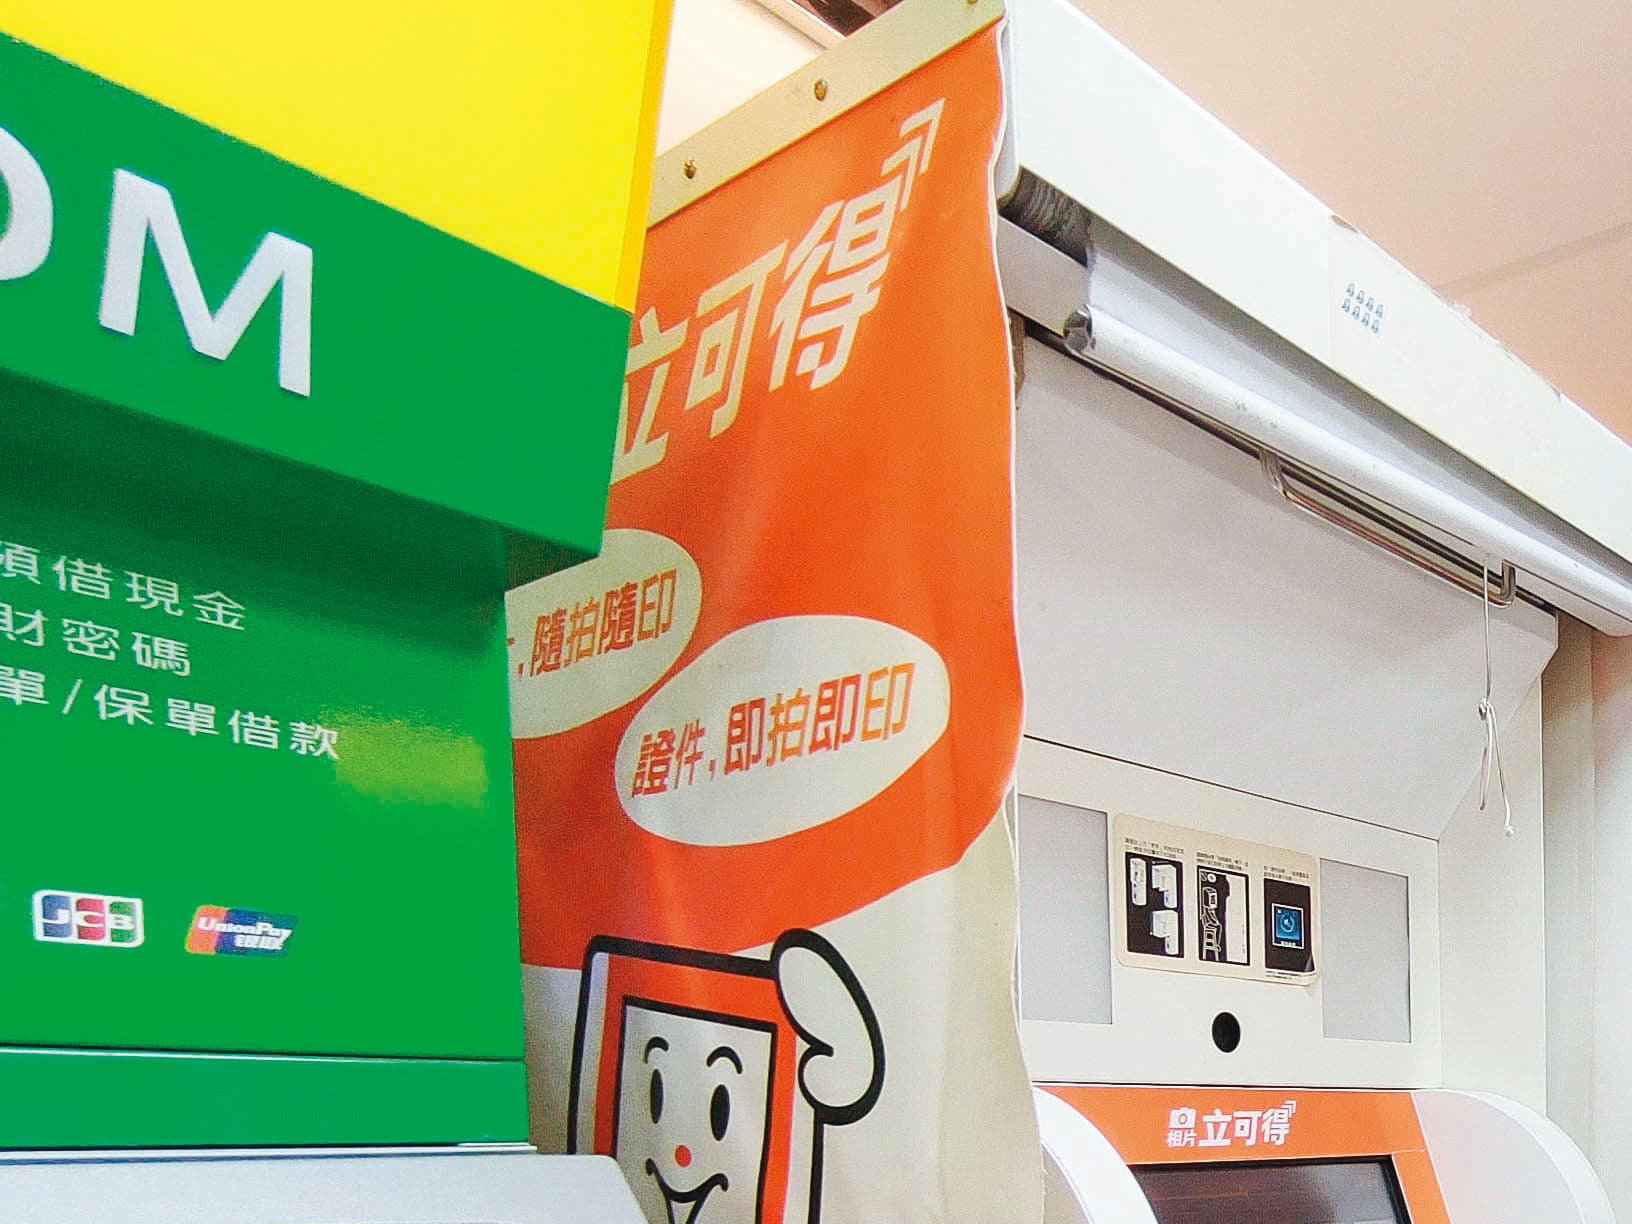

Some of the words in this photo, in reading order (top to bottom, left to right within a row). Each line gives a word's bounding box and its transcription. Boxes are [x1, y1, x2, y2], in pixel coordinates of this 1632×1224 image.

[610, 180, 903, 486] 立可得
[507, 569, 677, 680] ,隨拍隨印
[631, 662, 916, 798] 證件,即拍即印
[42, 907, 136, 932] JCB
[197, 916, 293, 939] UnionPay
[1199, 1105, 1292, 1147] 立可得
